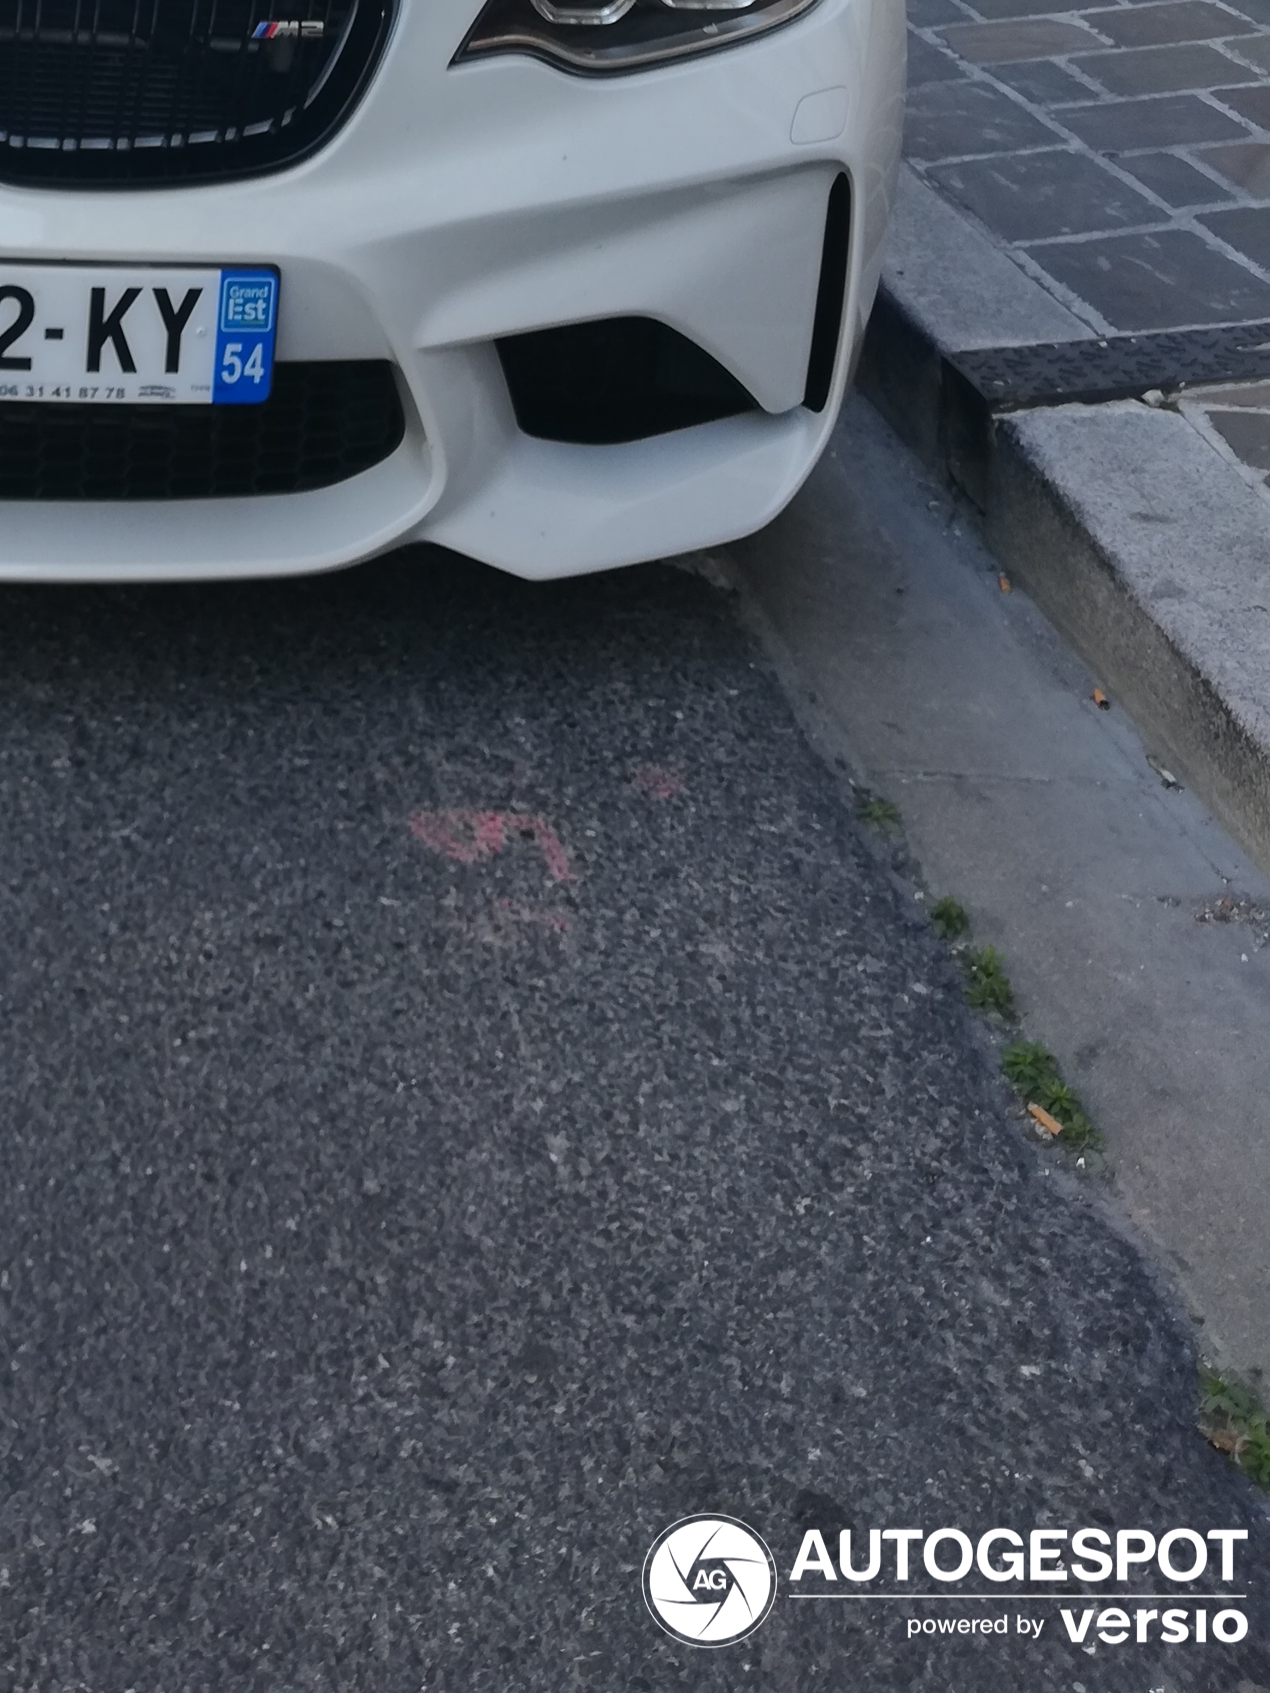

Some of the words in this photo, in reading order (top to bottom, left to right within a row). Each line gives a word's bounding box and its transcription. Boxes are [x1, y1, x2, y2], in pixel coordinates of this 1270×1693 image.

[271, 20, 324, 38] M2
[230, 285, 268, 299] Grand
[228, 298, 267, 321] Est
[221, 343, 265, 385] 54
[25, 384, 44, 397] 31
[50, 385, 71, 398] 41
